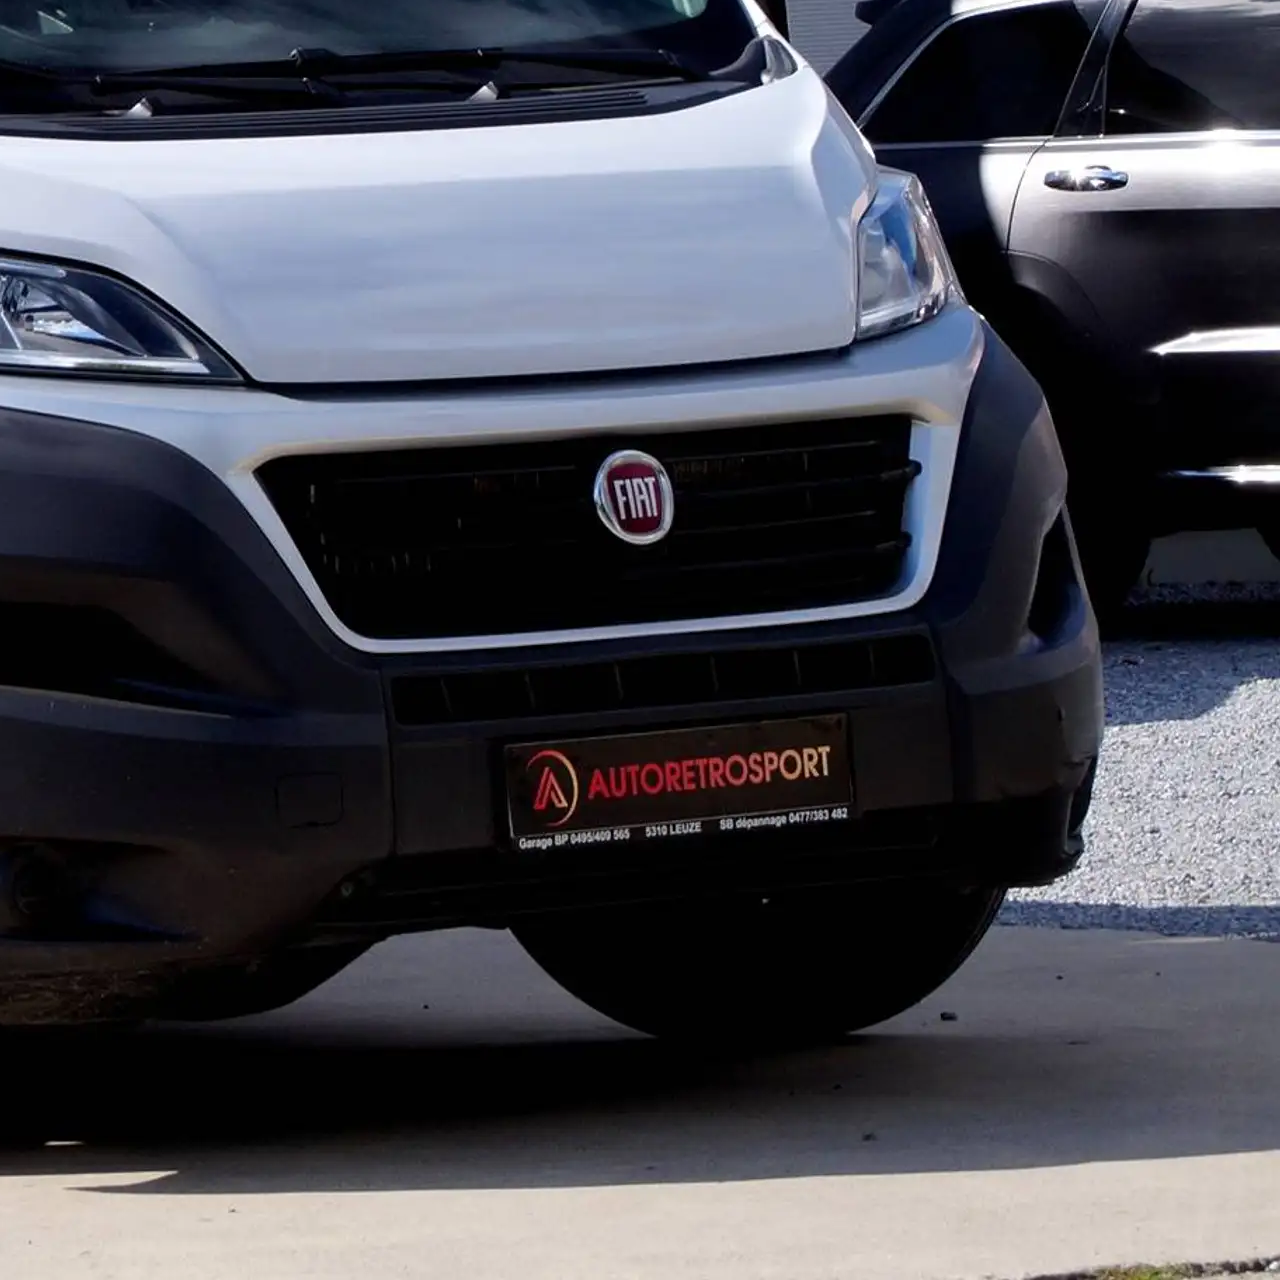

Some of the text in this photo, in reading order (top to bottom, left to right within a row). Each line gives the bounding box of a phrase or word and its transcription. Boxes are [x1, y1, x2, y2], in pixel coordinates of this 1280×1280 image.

[613, 476, 658, 521] FIAT
[586, 745, 832, 800] AUTORETROSPORT
[645, 821, 702, 838] 5310 LEUZE
[735, 815, 787, 830] dépannage
[519, 837, 553, 850] Garage
[554, 833, 569, 846] BP
